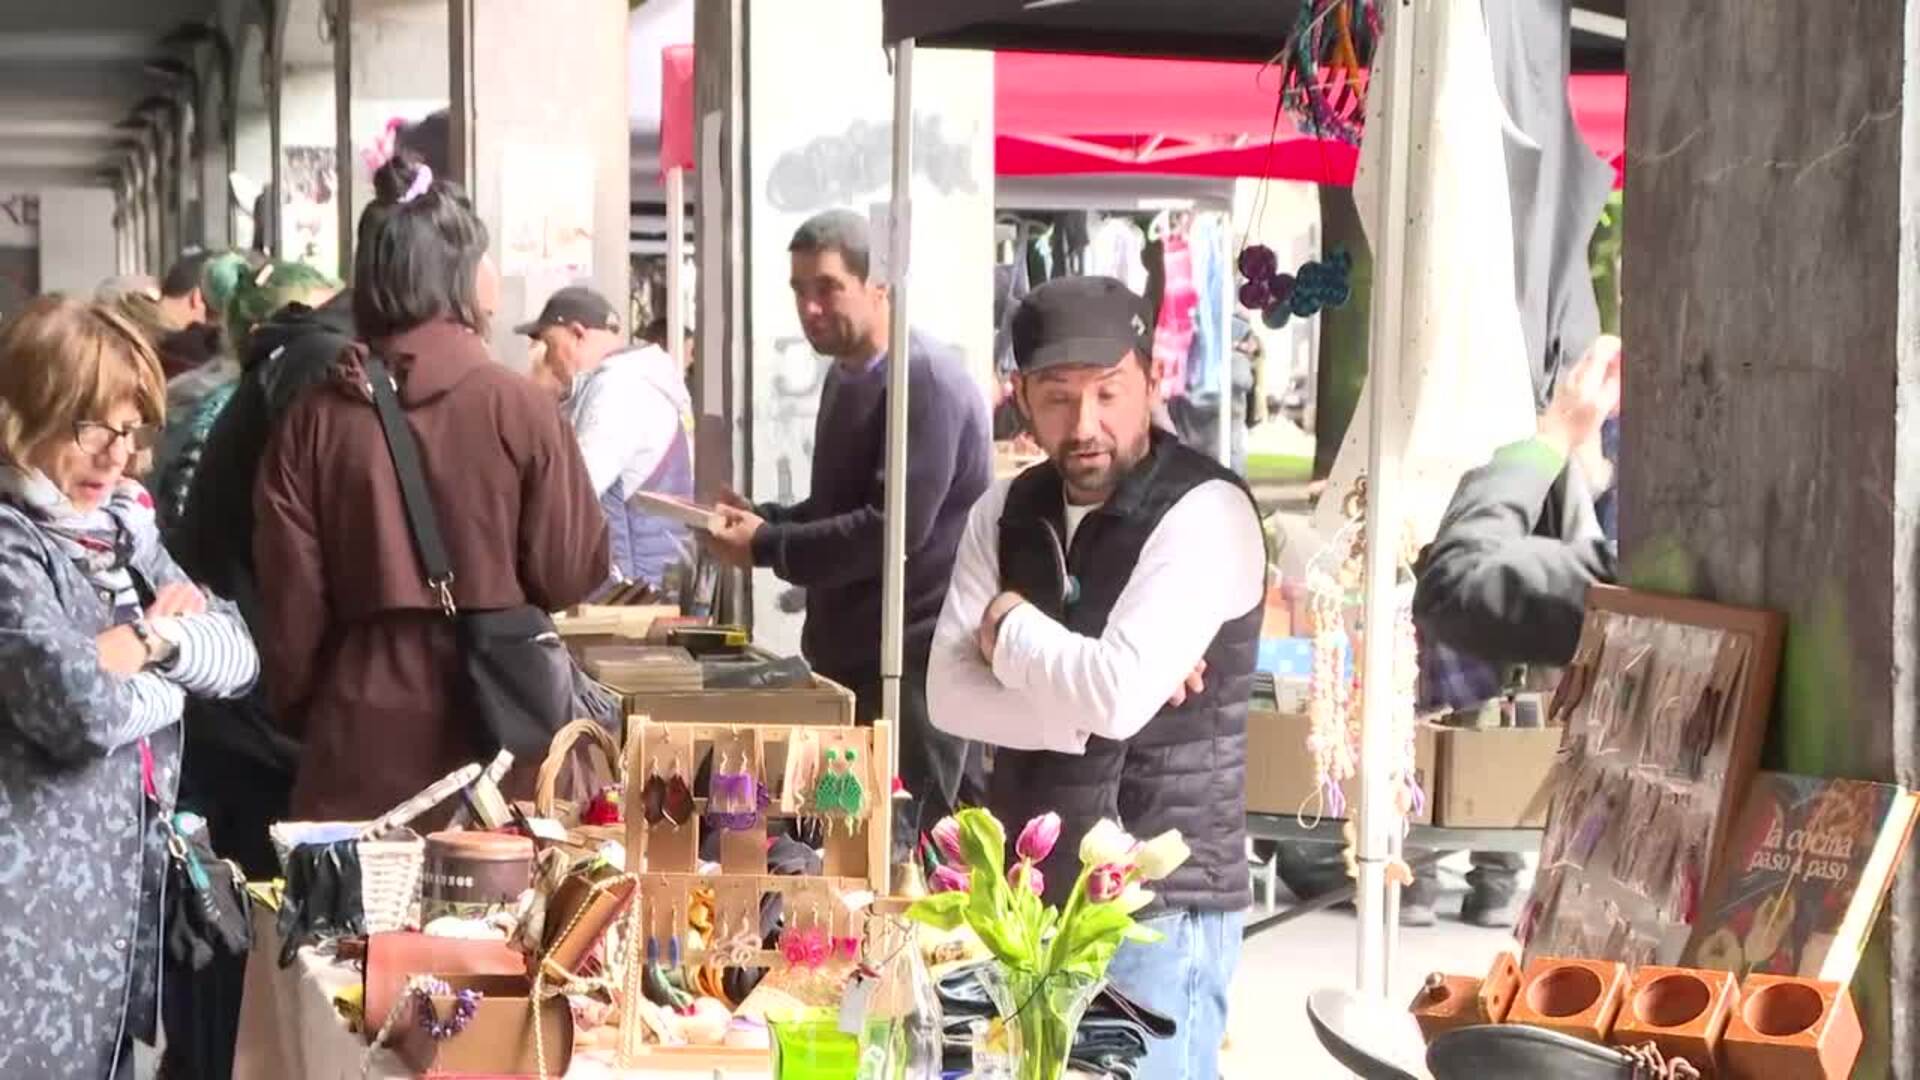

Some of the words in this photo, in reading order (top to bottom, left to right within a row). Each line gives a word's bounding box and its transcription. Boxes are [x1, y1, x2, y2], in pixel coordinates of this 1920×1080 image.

[1762, 818, 1783, 849] la
[1786, 827, 1853, 859] cocina
[1746, 851, 1791, 873] paso
[1803, 859, 1849, 882] paso
